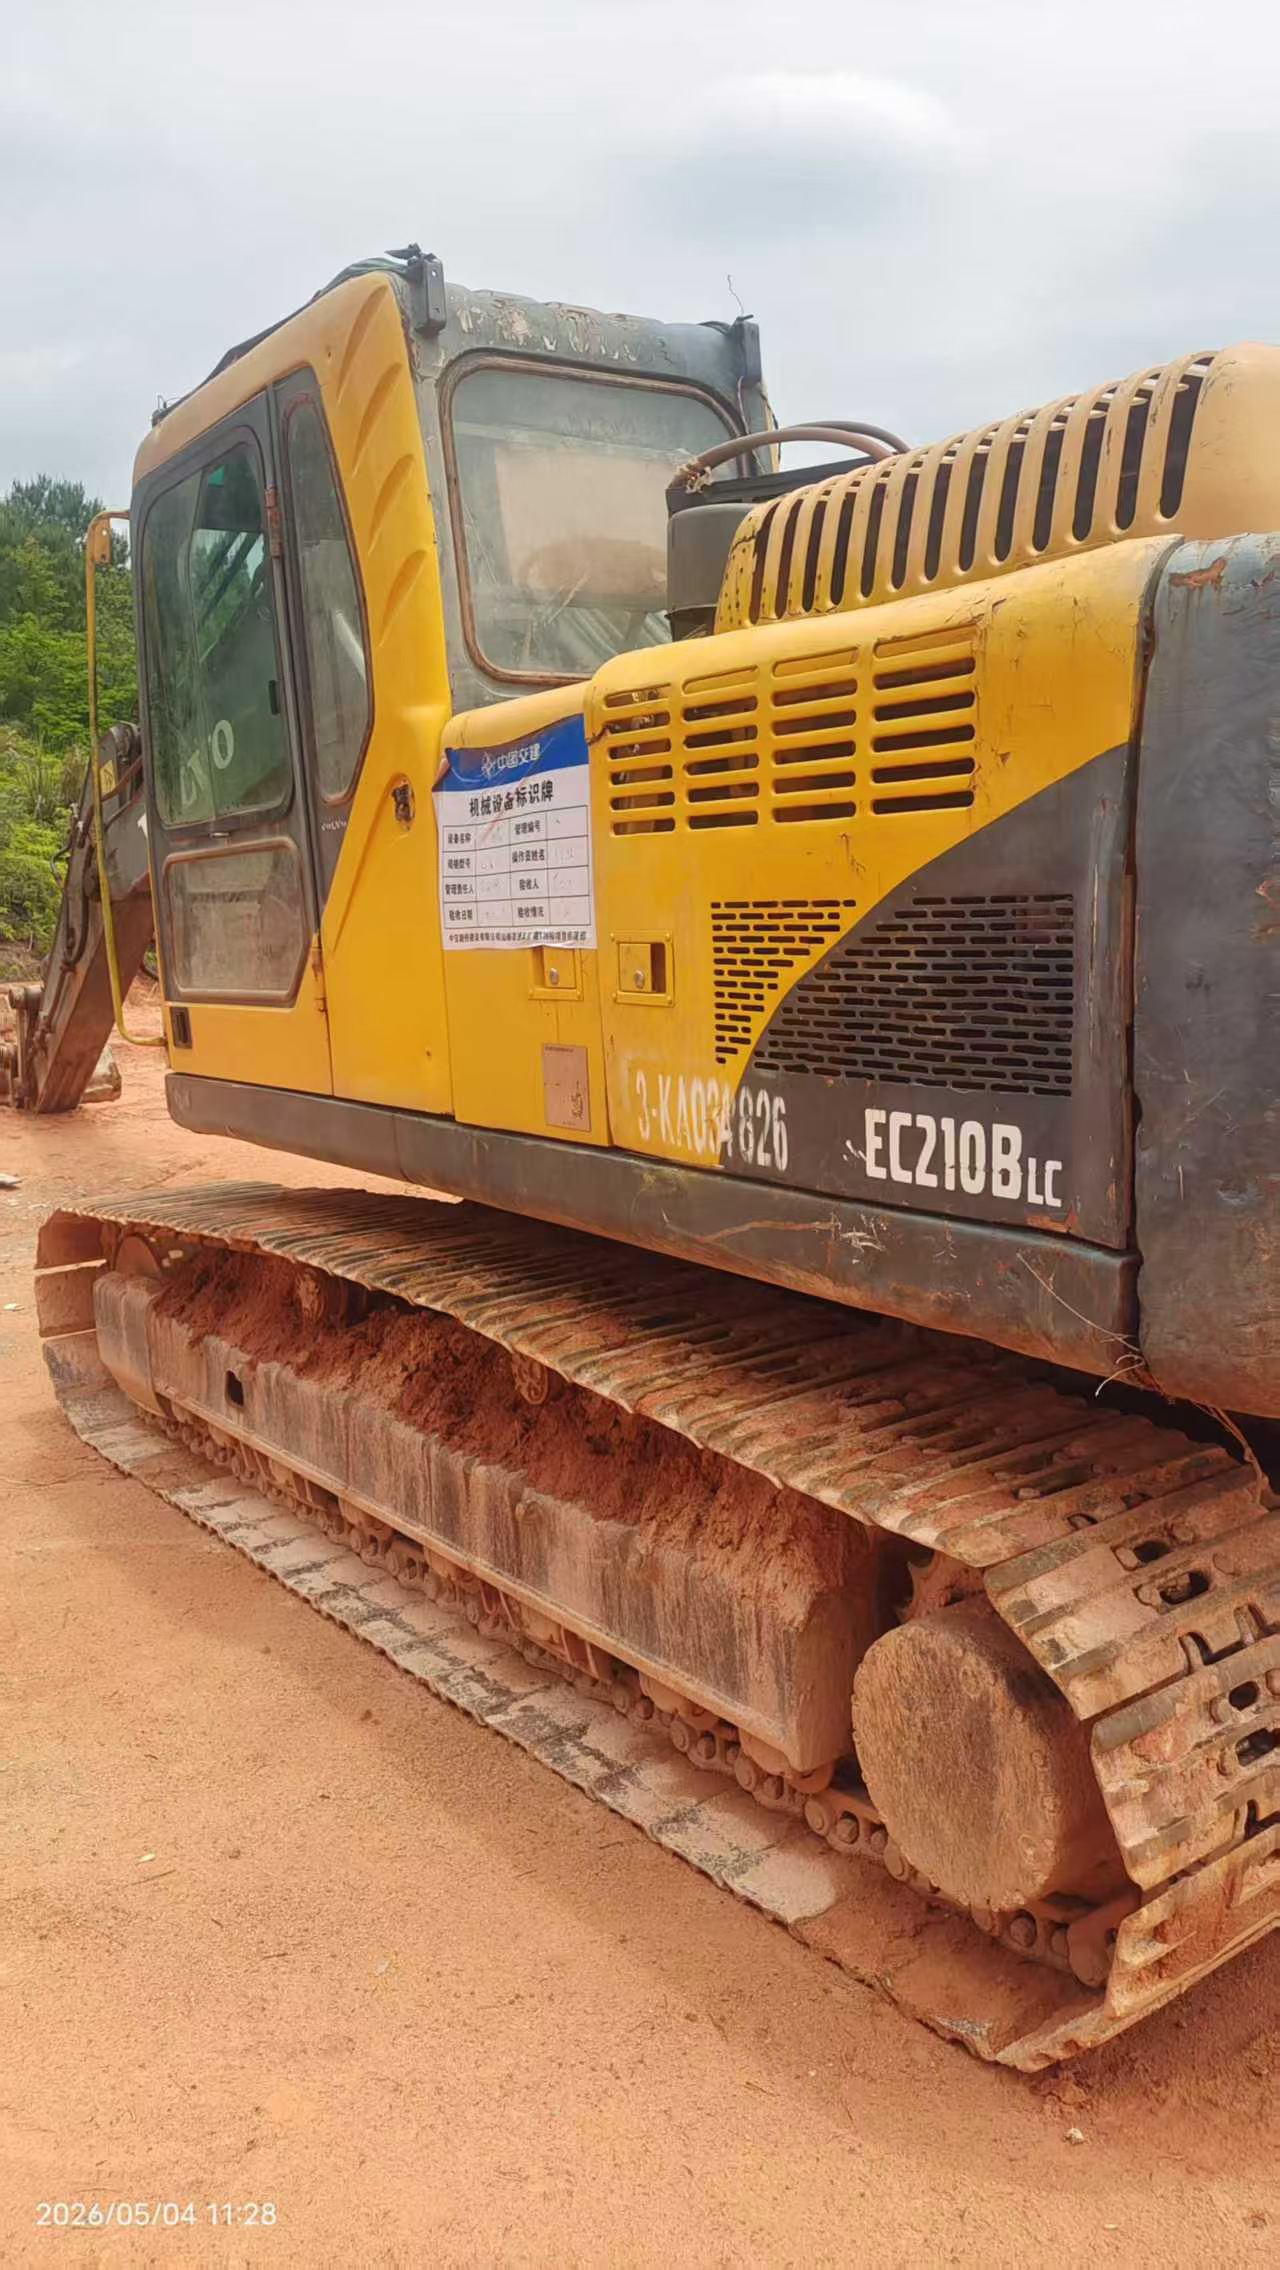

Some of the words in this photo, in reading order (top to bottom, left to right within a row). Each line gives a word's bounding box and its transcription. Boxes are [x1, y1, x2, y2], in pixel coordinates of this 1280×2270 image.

[497, 743, 541, 769] 中国交建
[468, 780, 554, 817] 机械设备标识牌
[519, 878, 539, 891] 验收人
